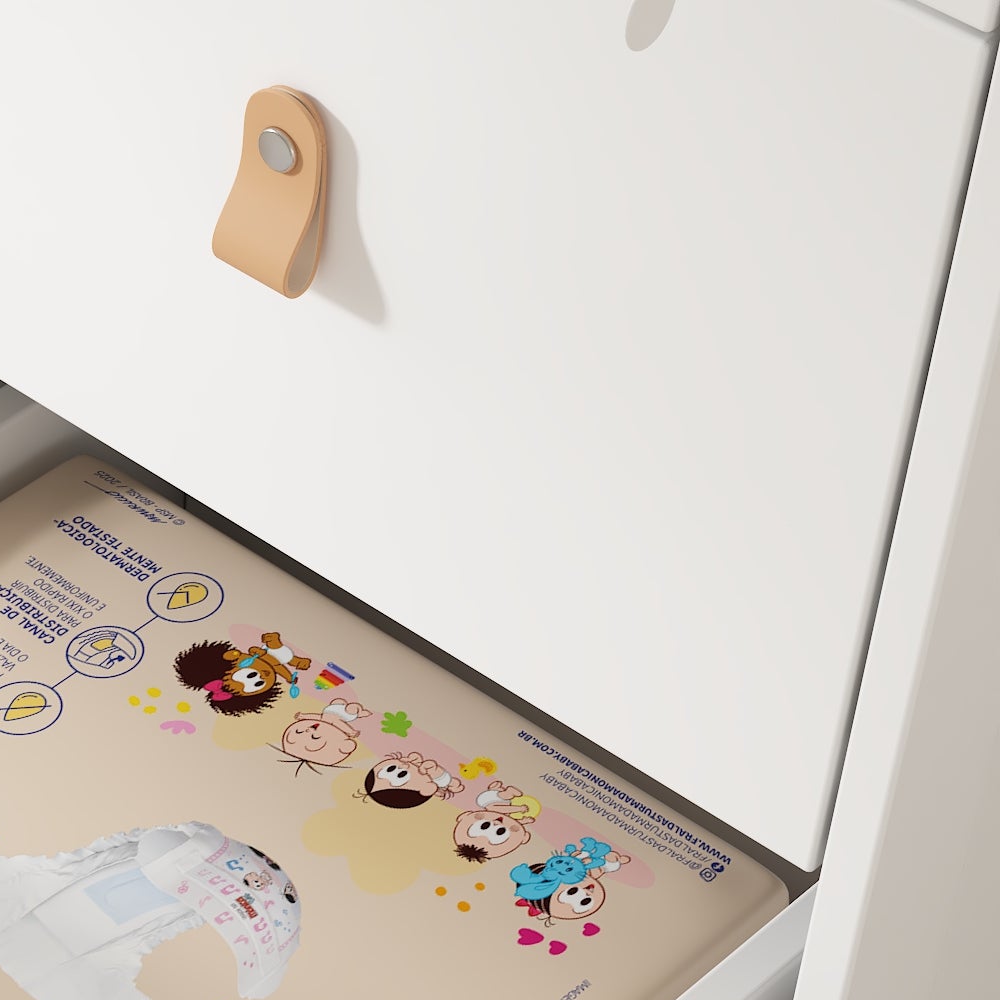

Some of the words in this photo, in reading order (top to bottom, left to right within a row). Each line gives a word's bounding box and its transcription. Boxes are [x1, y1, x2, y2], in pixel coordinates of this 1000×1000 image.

[71, 514, 123, 549] TESTADO
[52, 518, 149, 581] DERMATOLOGICA-
[119, 546, 162, 574] MENTE
[24, 555, 98, 606] UNIFORMEMENTE.
[32, 577, 68, 602] RÁPIDO
[10, 579, 59, 612] DISTRIBUIR
[63, 599, 84, 614] XIXI
[0, 605, 19, 619] DE
[53, 609, 80, 627] PARA
[80, 610, 93, 619] O
[17, 617, 55, 644] CANAL
[0, 643, 20, 656] DIA
[17, 653, 28, 661] O
[517, 729, 732, 866] WWW.FRALDASTURMADAMONICABABY.COM.BR
[539, 773, 702, 871] @FRALDASTURMADAMONICABABY
